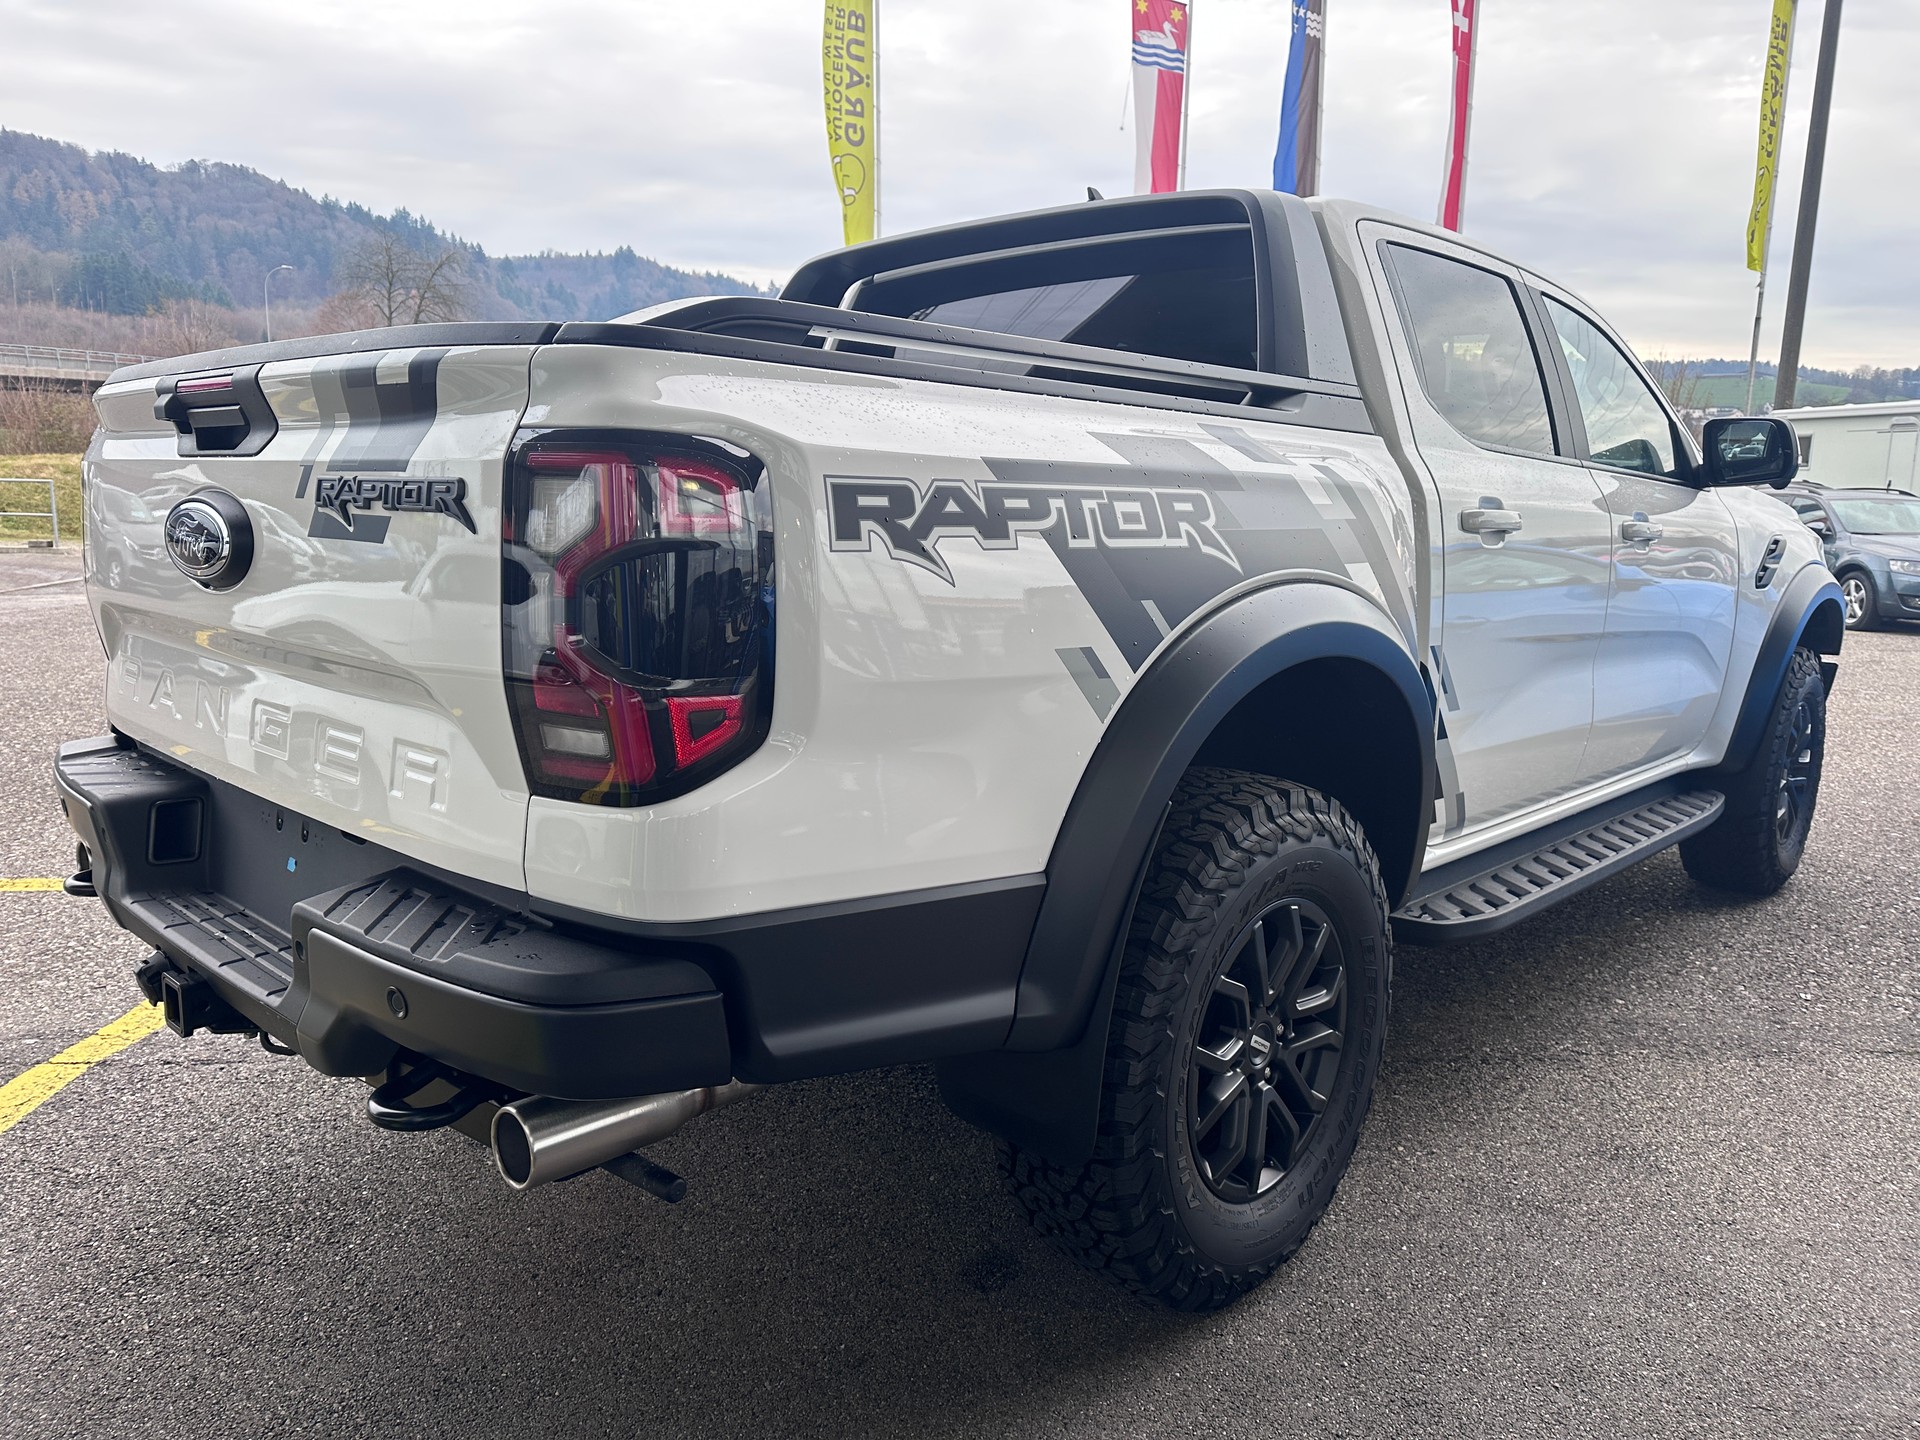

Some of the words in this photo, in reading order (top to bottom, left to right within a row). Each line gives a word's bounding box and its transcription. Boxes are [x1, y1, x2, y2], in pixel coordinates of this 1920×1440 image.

[172, 516, 209, 561] Ford
[314, 474, 478, 536] RAPTOR
[823, 474, 1244, 588] RAPTOR
[118, 654, 452, 814] RANGER
